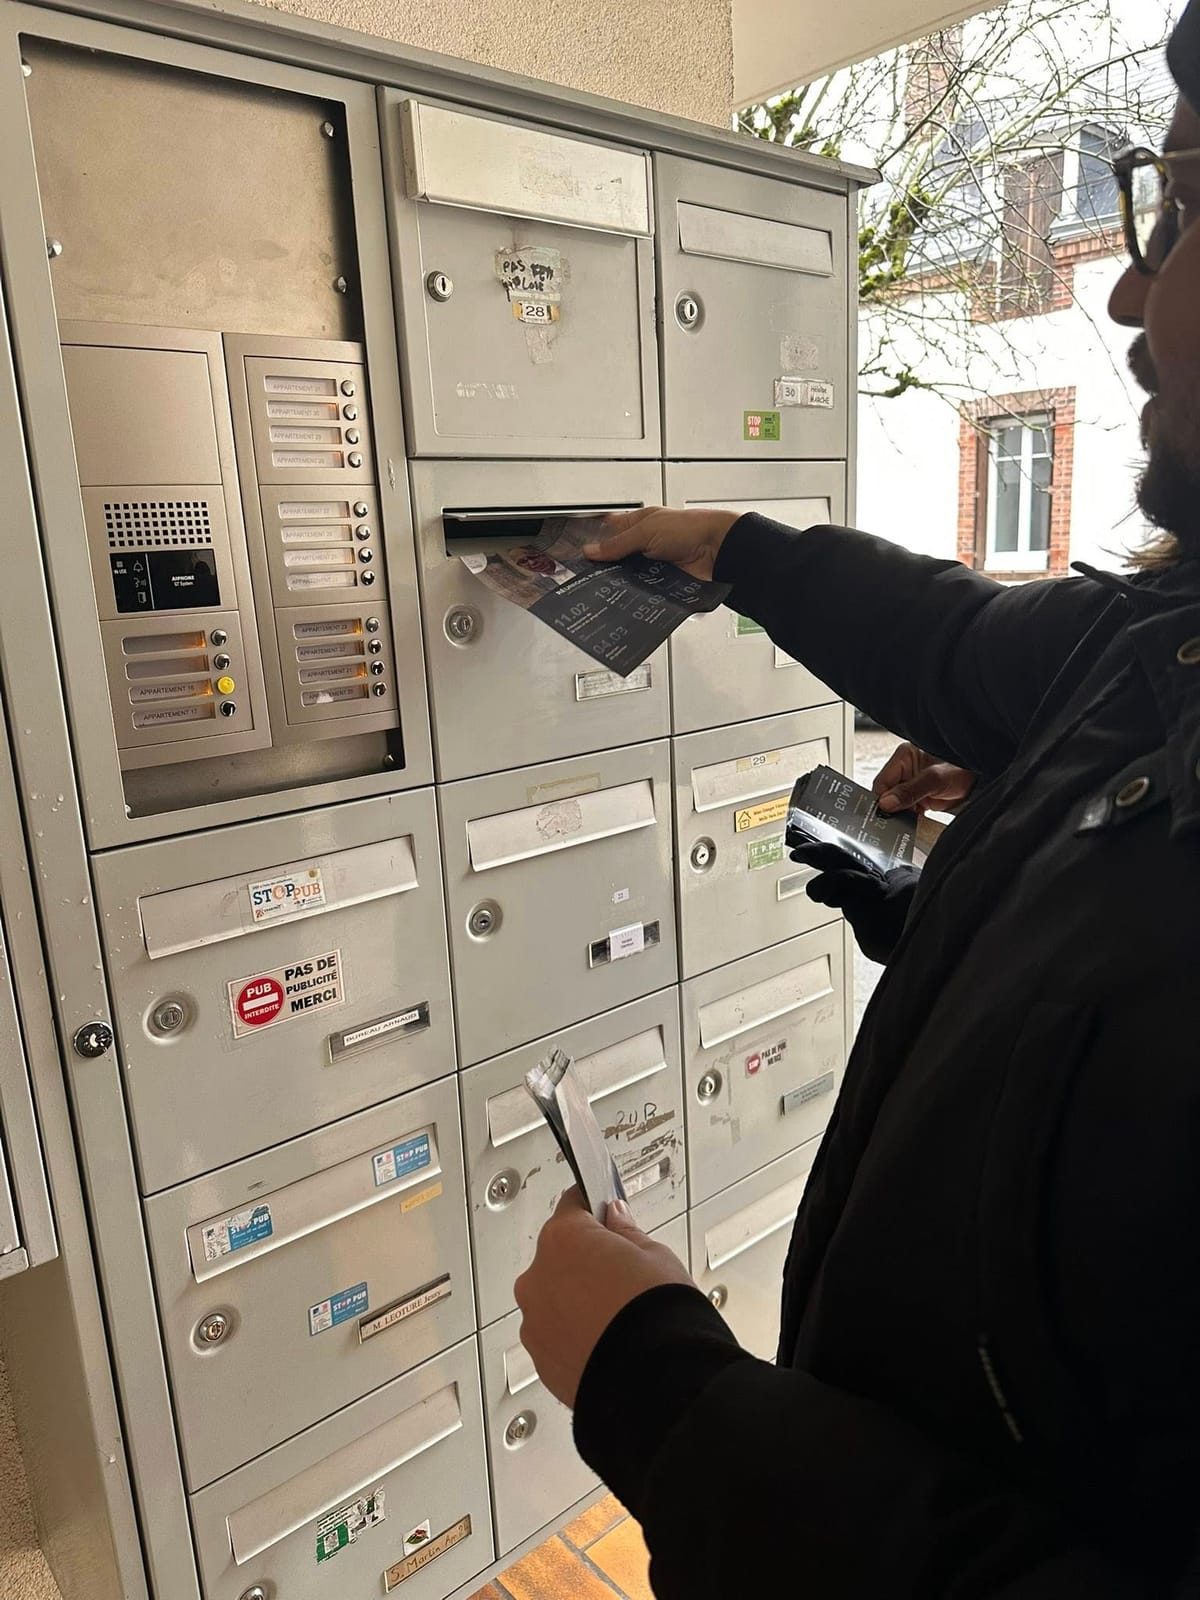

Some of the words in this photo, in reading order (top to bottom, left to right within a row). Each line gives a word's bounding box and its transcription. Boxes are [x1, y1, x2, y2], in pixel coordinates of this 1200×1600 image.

[525, 305, 545, 317] 28
[785, 387, 796, 397] 30
[747, 415, 762, 425] STOP
[553, 602, 590, 628] 11.02
[301, 626, 341, 634] APPARTEMENT
[592, 625, 629, 654] 04.03
[300, 647, 339, 656] APPARTEMENT
[307, 669, 346, 678] APPARTEMENT
[139, 686, 187, 696] APPARTEMENT
[143, 710, 190, 721] APPARTEMENT
[753, 755, 766, 766] 29
[834, 783, 854, 811] 04.03
[252, 883, 295, 906] STOP
[293, 882, 321, 900] PUB
[284, 963, 313, 981] PAS
[317, 955, 336, 971] DE
[246, 982, 272, 999] PUB
[285, 969, 338, 995] PUBLICITÉ
[290, 987, 337, 1013] MERCI
[244, 1003, 280, 1020] INTERDITE
[345, 1025, 381, 1043] BUREAU
[382, 1012, 417, 1029] ARNAUD
[761, 1048, 771, 1059] PAS
[771, 1045, 777, 1054] DE
[396, 1149, 415, 1162] STOP
[415, 1143, 428, 1154] PUB
[253, 1213, 270, 1225] PUB
[332, 1298, 352, 1311] STOP
[352, 1291, 366, 1302] PUB
[406, 1546, 441, 1573] Martin
